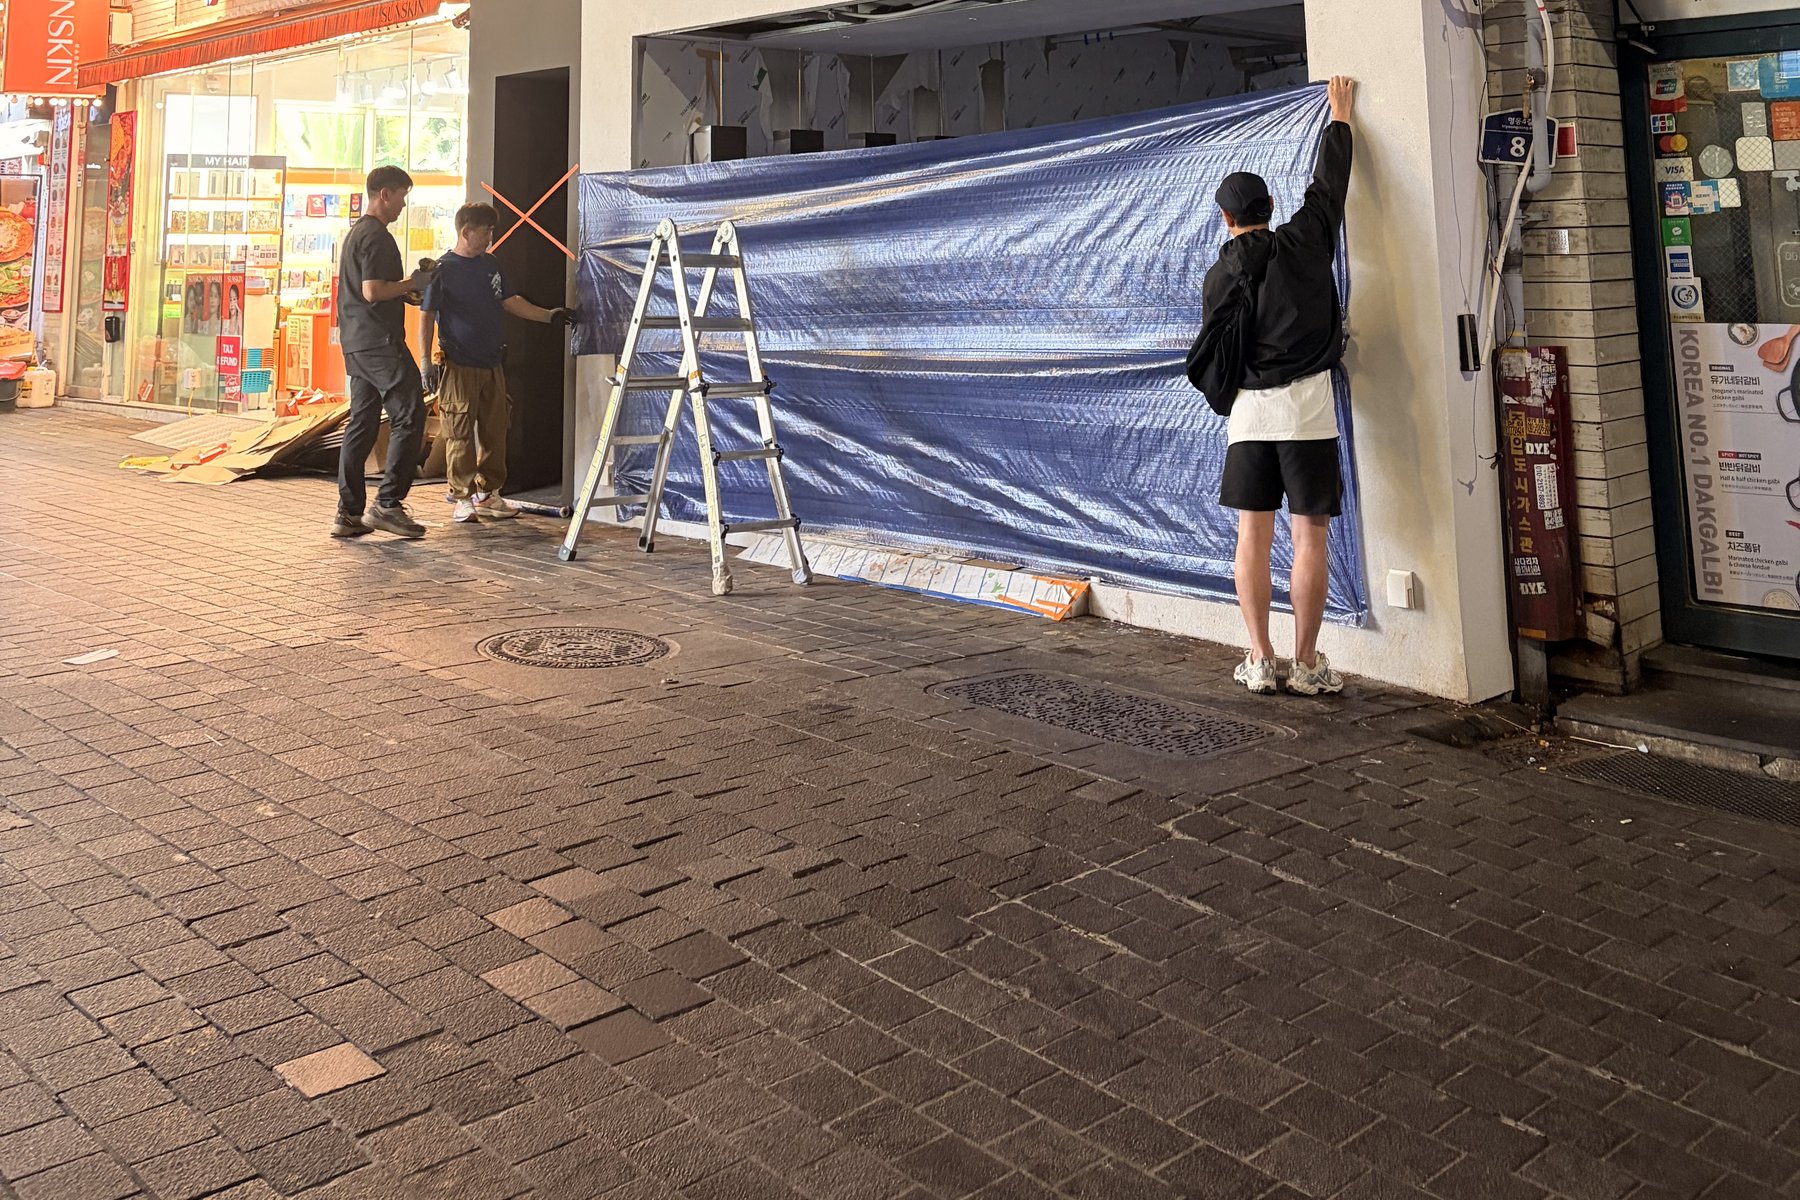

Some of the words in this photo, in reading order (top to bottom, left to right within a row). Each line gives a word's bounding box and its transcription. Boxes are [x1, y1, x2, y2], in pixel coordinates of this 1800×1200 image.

[1510, 137, 1526, 157] 8
[205, 157, 221, 166] MY
[223, 157, 248, 167] HAIR
[1665, 166, 1685, 174] VISA
[222, 344, 234, 353] TAX
[1679, 329, 1705, 408] KOREA
[1687, 414, 1711, 466] NO.1
[1719, 461, 1760, 473] 반반닭갈비
[1693, 474, 1724, 595] DAKGALBI
